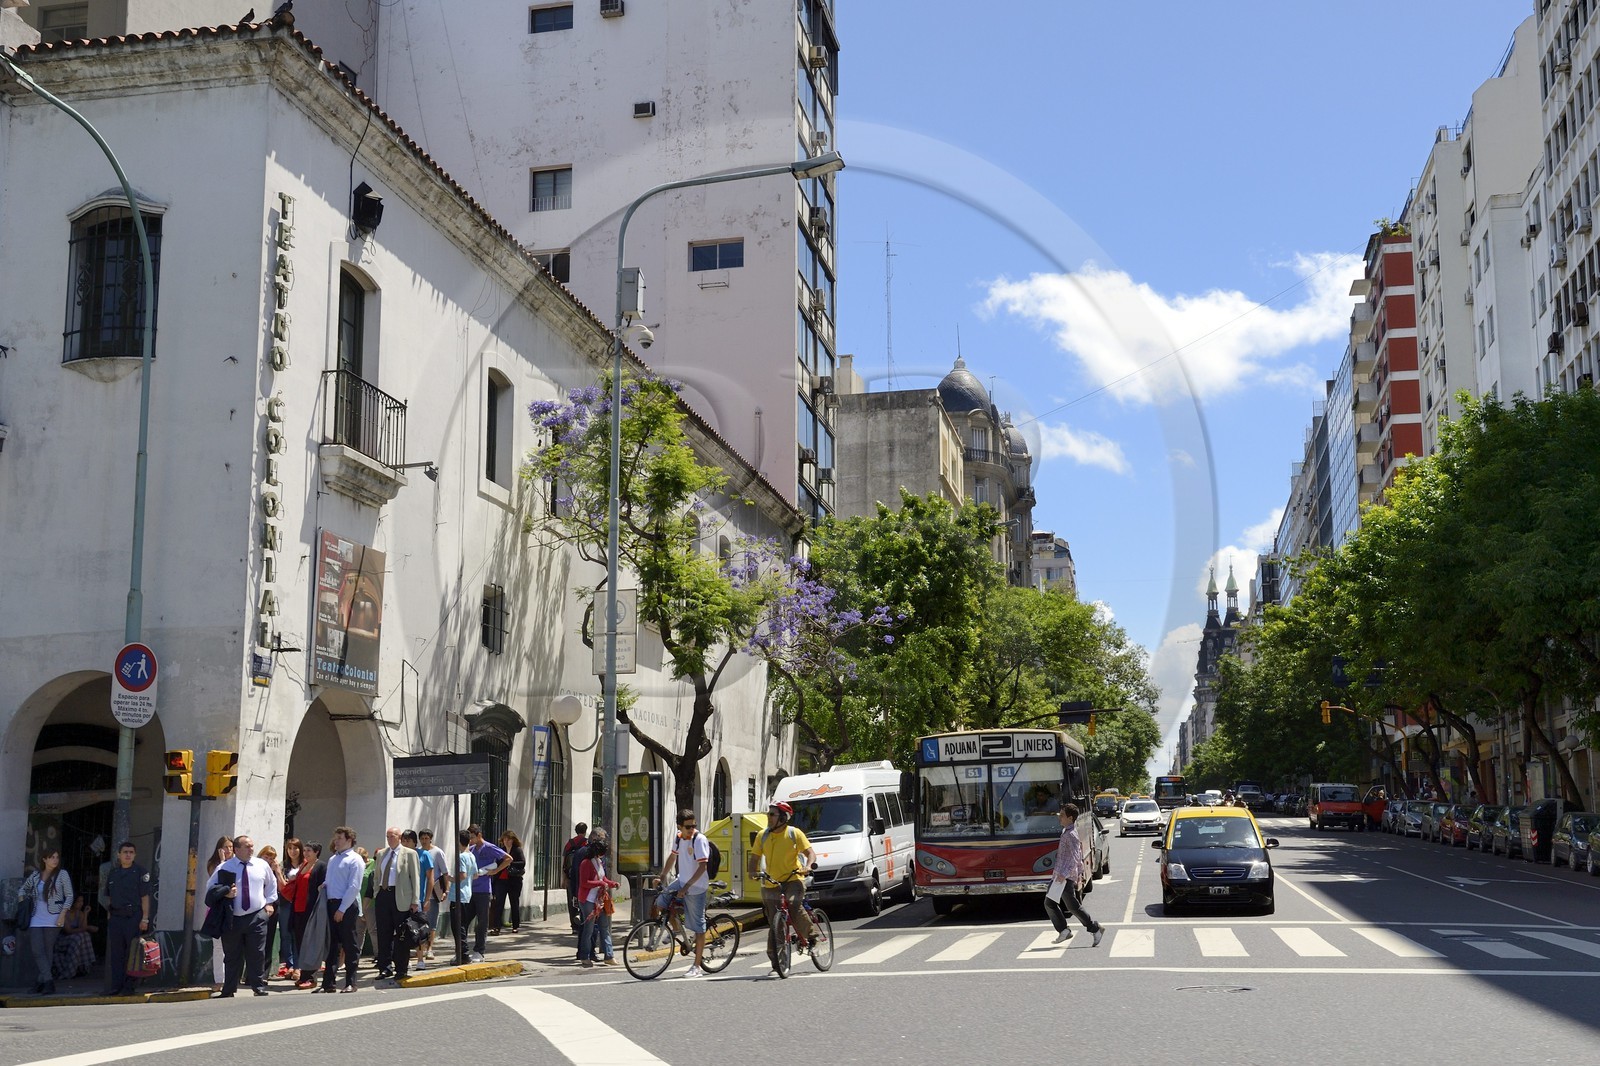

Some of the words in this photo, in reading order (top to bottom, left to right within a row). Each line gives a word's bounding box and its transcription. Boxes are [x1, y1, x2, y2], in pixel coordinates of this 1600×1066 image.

[270, 192, 291, 371] TEATRO
[260, 397, 281, 649] COLONIAL
[634, 706, 667, 728] NACIONAL
[945, 741, 977, 755] ADUANA
[982, 736, 1011, 757] 2
[1017, 739, 1053, 751] LINIERS
[395, 768, 426, 776] Avenida
